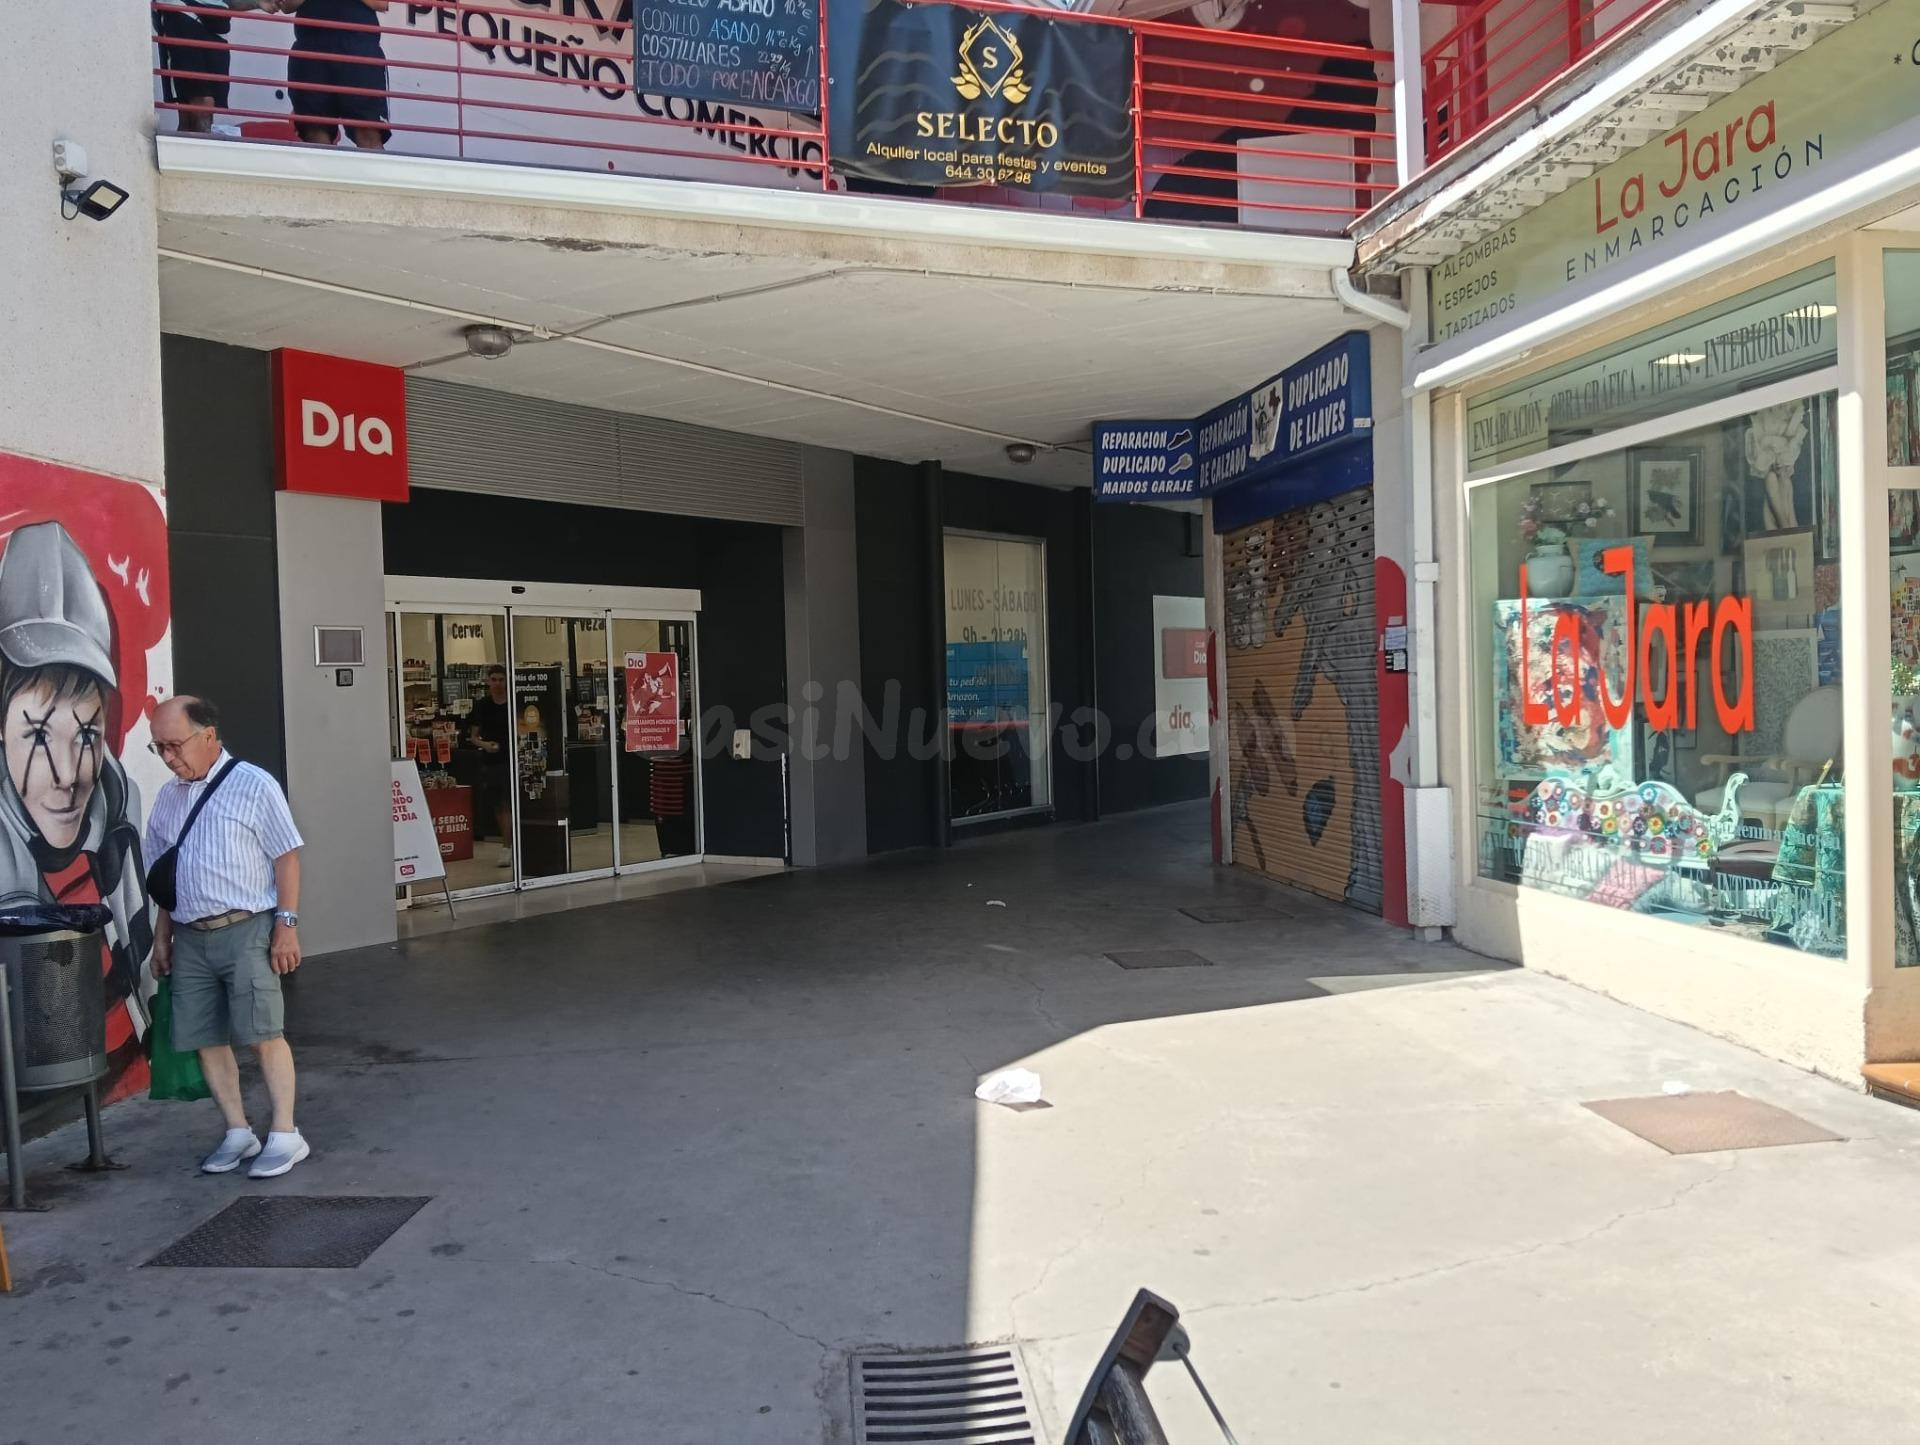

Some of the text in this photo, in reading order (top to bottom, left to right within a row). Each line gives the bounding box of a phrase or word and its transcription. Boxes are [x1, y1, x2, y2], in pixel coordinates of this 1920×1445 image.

[642, 7, 700, 37] CODILLO
[708, 18, 760, 45] ASADO
[407, 2, 626, 101] PEQUEÑO
[641, 34, 741, 68] COSTILLARES
[982, 46, 998, 69] S
[641, 59, 818, 107] TODO POR ENCARGO
[916, 111, 1058, 148] SELECTO
[866, 141, 1107, 175] Alquiler local para fiestas y eventos
[945, 165, 973, 178] 644
[977, 167, 994, 180] 30
[1595, 99, 1777, 235] La Jara
[1566, 133, 1824, 282] ENMARCACIÓN
[1444, 227, 1518, 281] ALFOMBRAS
[1444, 270, 1498, 311] ESPEJOS
[1445, 293, 1516, 339] TAPIZADOS
[1648, 347, 1692, 395] TELAS
[1704, 301, 1822, 379] INTERIORISMO
[1288, 352, 1349, 412] DUPLICADO
[1101, 430, 1168, 450] REPARACION
[1289, 398, 1346, 451] DE LLAVES
[1102, 455, 1166, 474] DUPLICADO
[1200, 445, 1247, 488] DE CALZADO
[1102, 479, 1193, 495] MANDOS GARAJE
[950, 588, 985, 611] LUNES
[1519, 545, 1756, 735] La Jara
